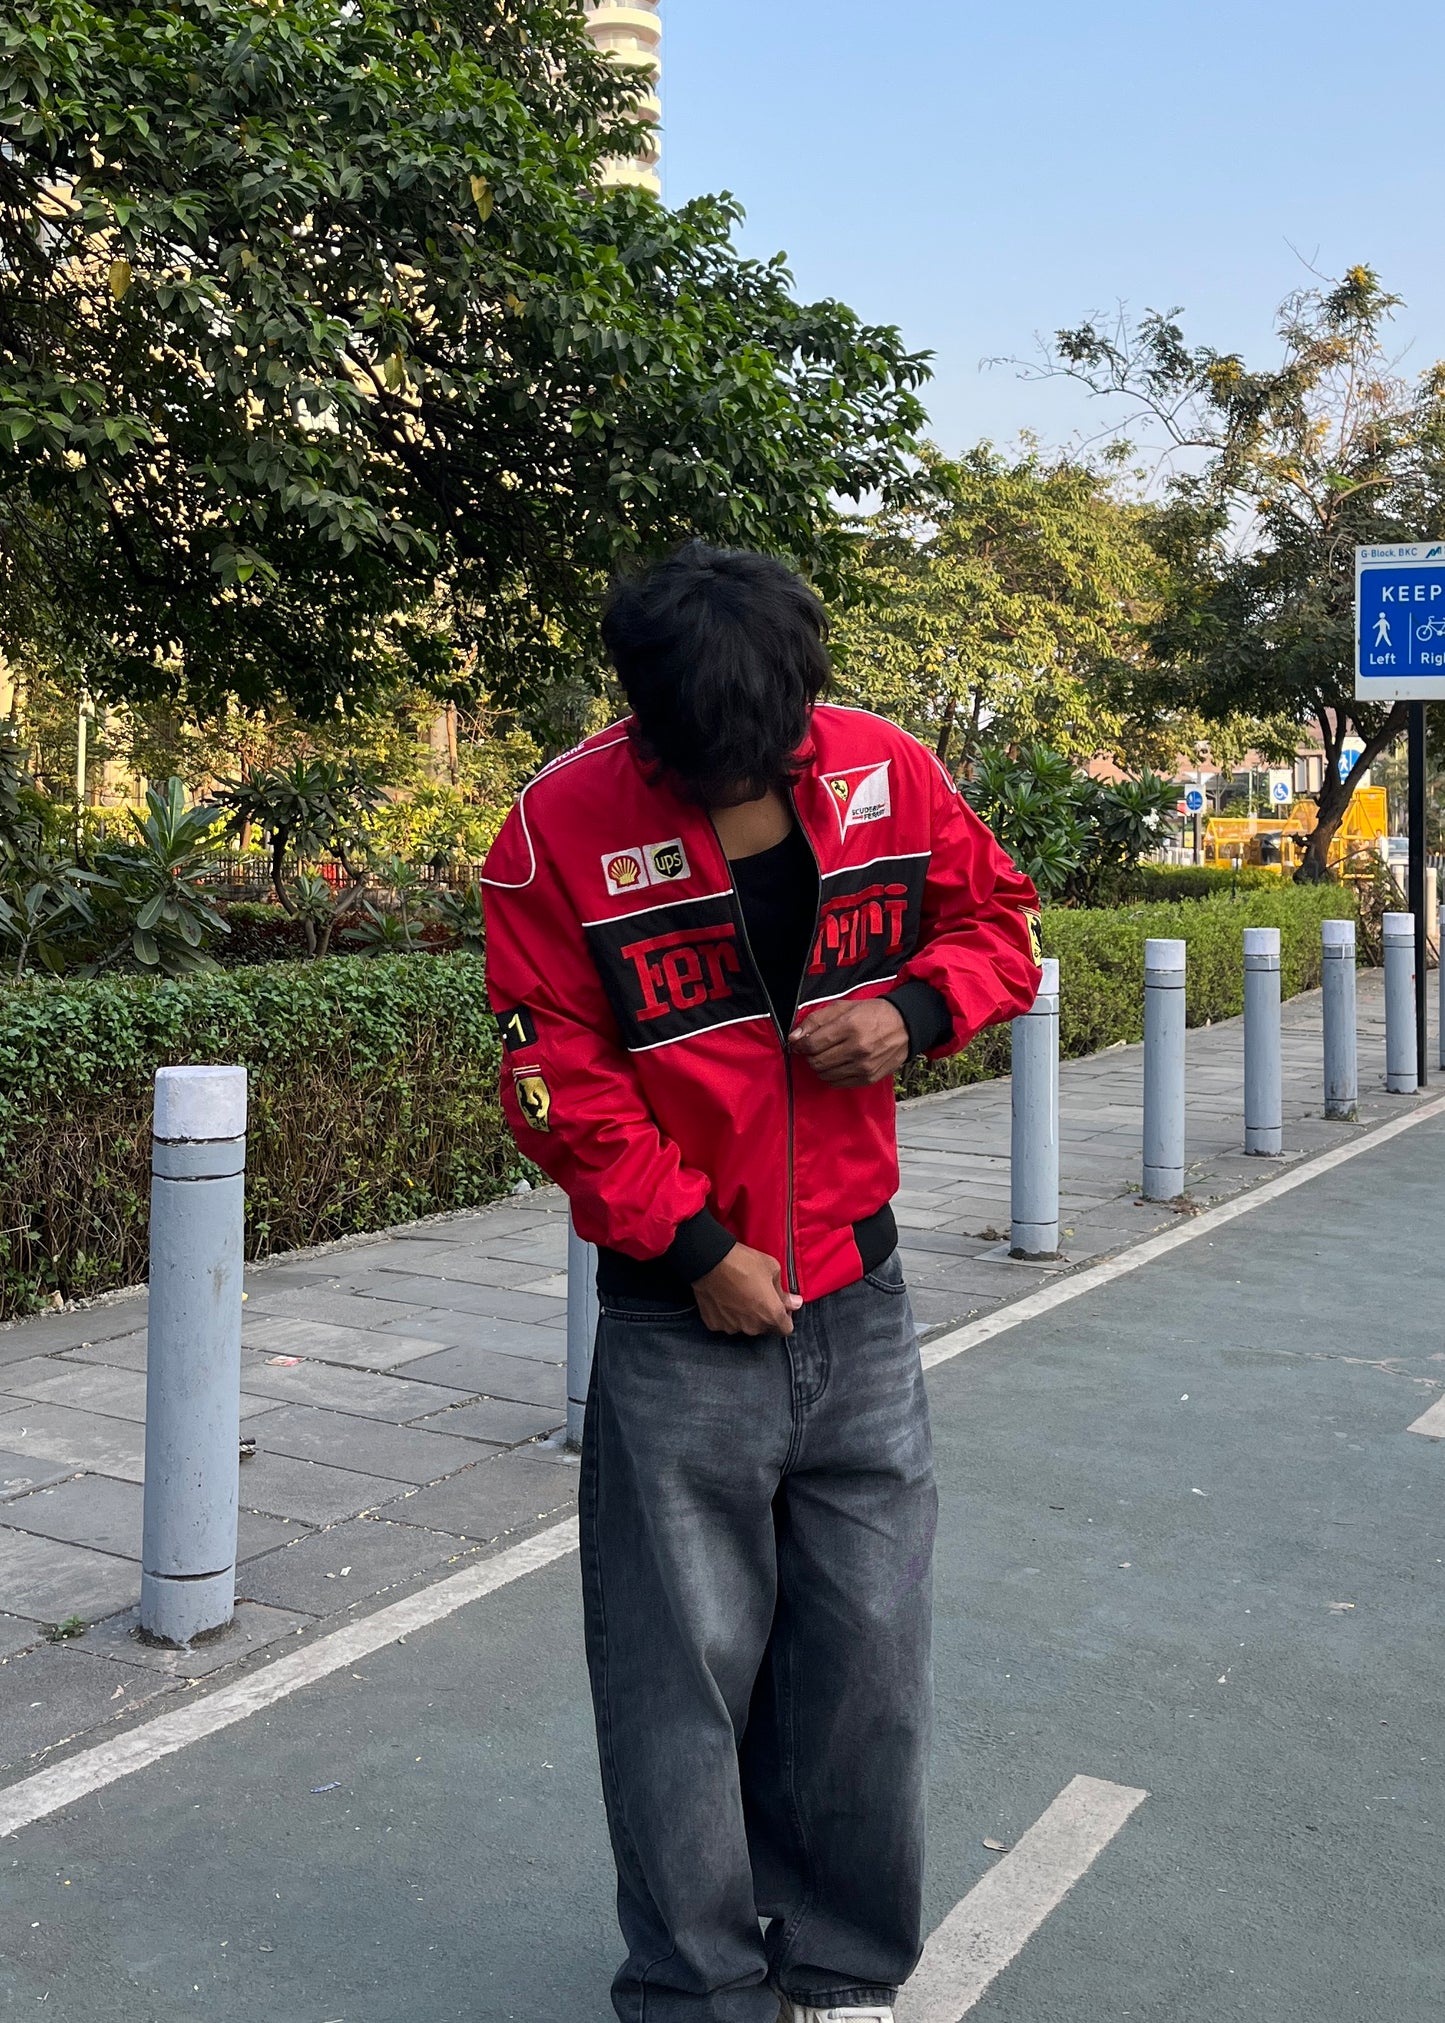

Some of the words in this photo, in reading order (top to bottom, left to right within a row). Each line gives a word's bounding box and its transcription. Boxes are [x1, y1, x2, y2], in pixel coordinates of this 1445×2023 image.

[1398, 547, 1418, 557] BKC
[1382, 584, 1442, 602] KEEP
[1369, 652, 1396, 665] Left
